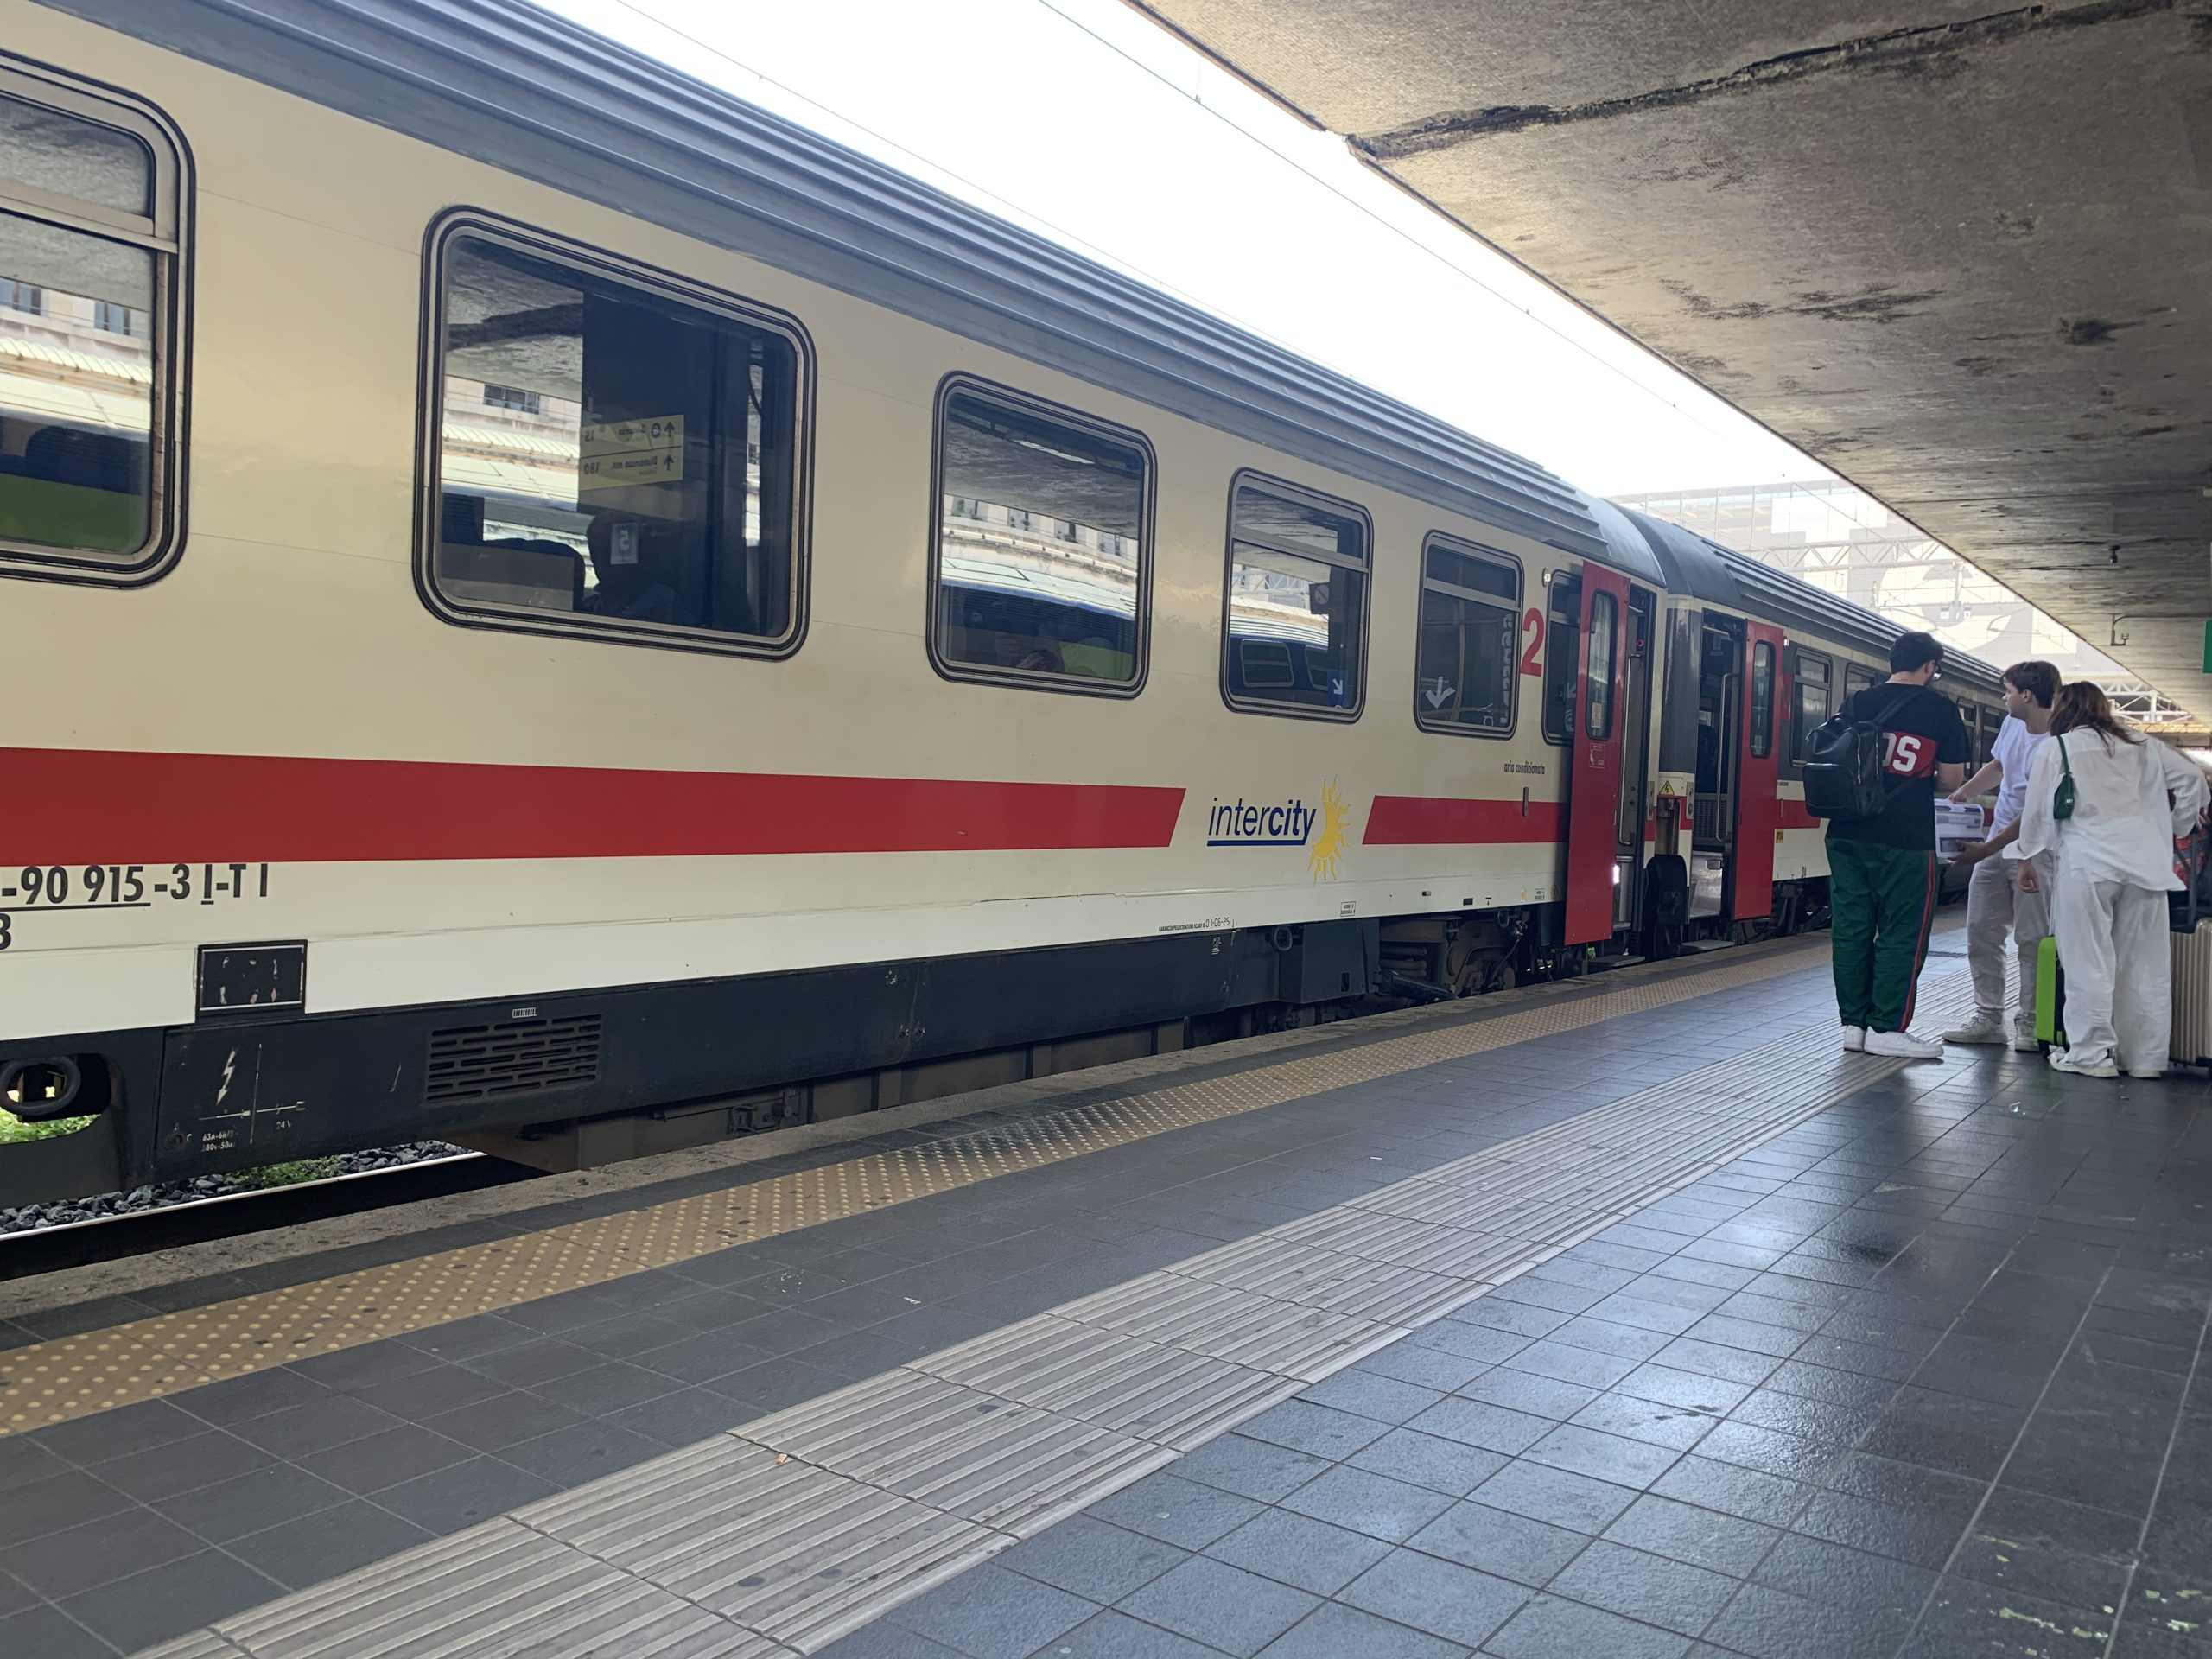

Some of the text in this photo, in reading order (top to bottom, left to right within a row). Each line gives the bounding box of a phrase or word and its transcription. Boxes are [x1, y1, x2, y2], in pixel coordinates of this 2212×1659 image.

[1521, 607, 1545, 677] 2
[1503, 760, 1546, 775] aria condizionata
[1207, 797, 1318, 846] intercity
